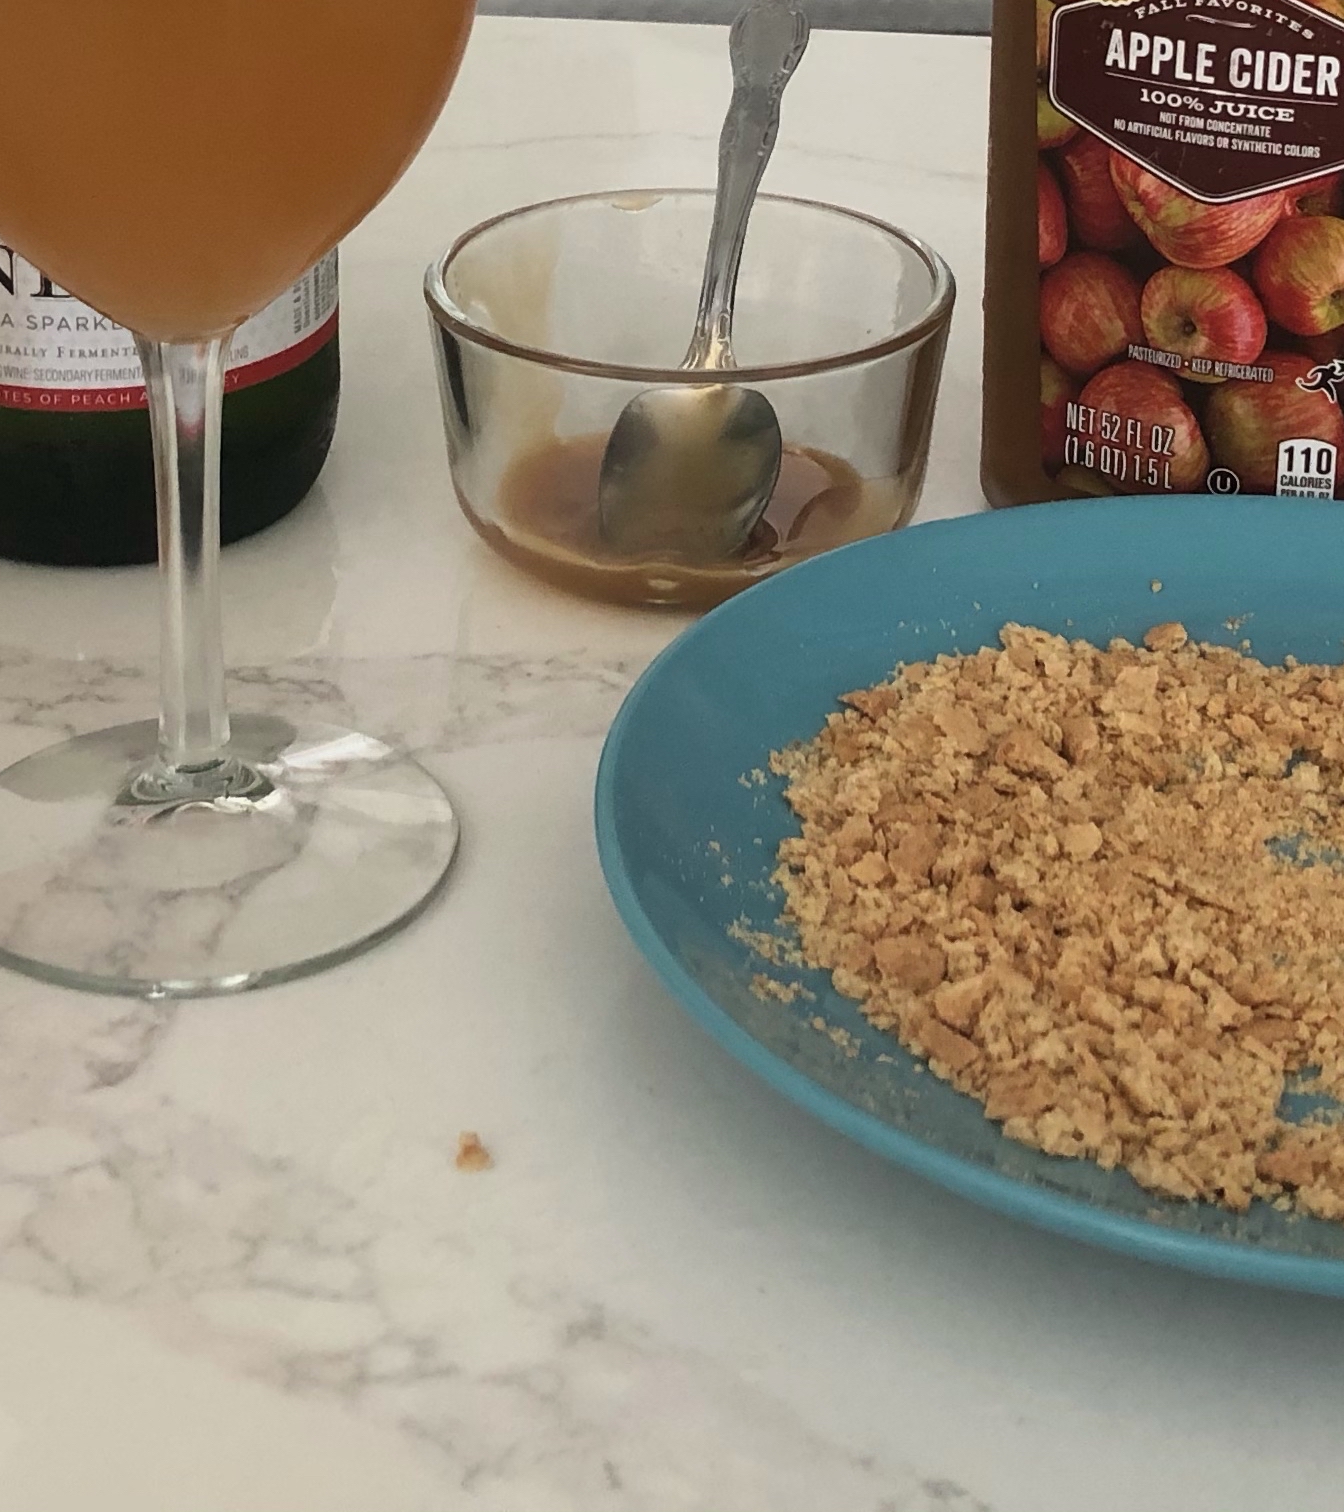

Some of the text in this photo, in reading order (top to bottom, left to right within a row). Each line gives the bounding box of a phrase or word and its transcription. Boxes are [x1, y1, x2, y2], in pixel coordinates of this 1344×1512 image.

[1105, 28, 1341, 97] APPLE CIDER
[1140, 88, 1295, 123] 100% JUICE
[1113, 118, 1321, 159] NO ARTIFICIAL FLAVORS OR SYNTHETIC COLORS
[1159, 111, 1272, 138] NOT FROM CONCENTRATE
[34, 367, 95, 381] SECONDARY
[1128, 344, 1274, 383] PASTEURIZED KEEP REFRIGERATED
[39, 391, 59, 405] OF
[71, 392, 131, 406] PEACH
[1066, 402, 1174, 456] NET 52 FL OZ
[1065, 434, 1172, 490] (1.6 QT) 1.5 L
[1284, 445, 1332, 475] 110
[1280, 474, 1332, 489] CALORIES
